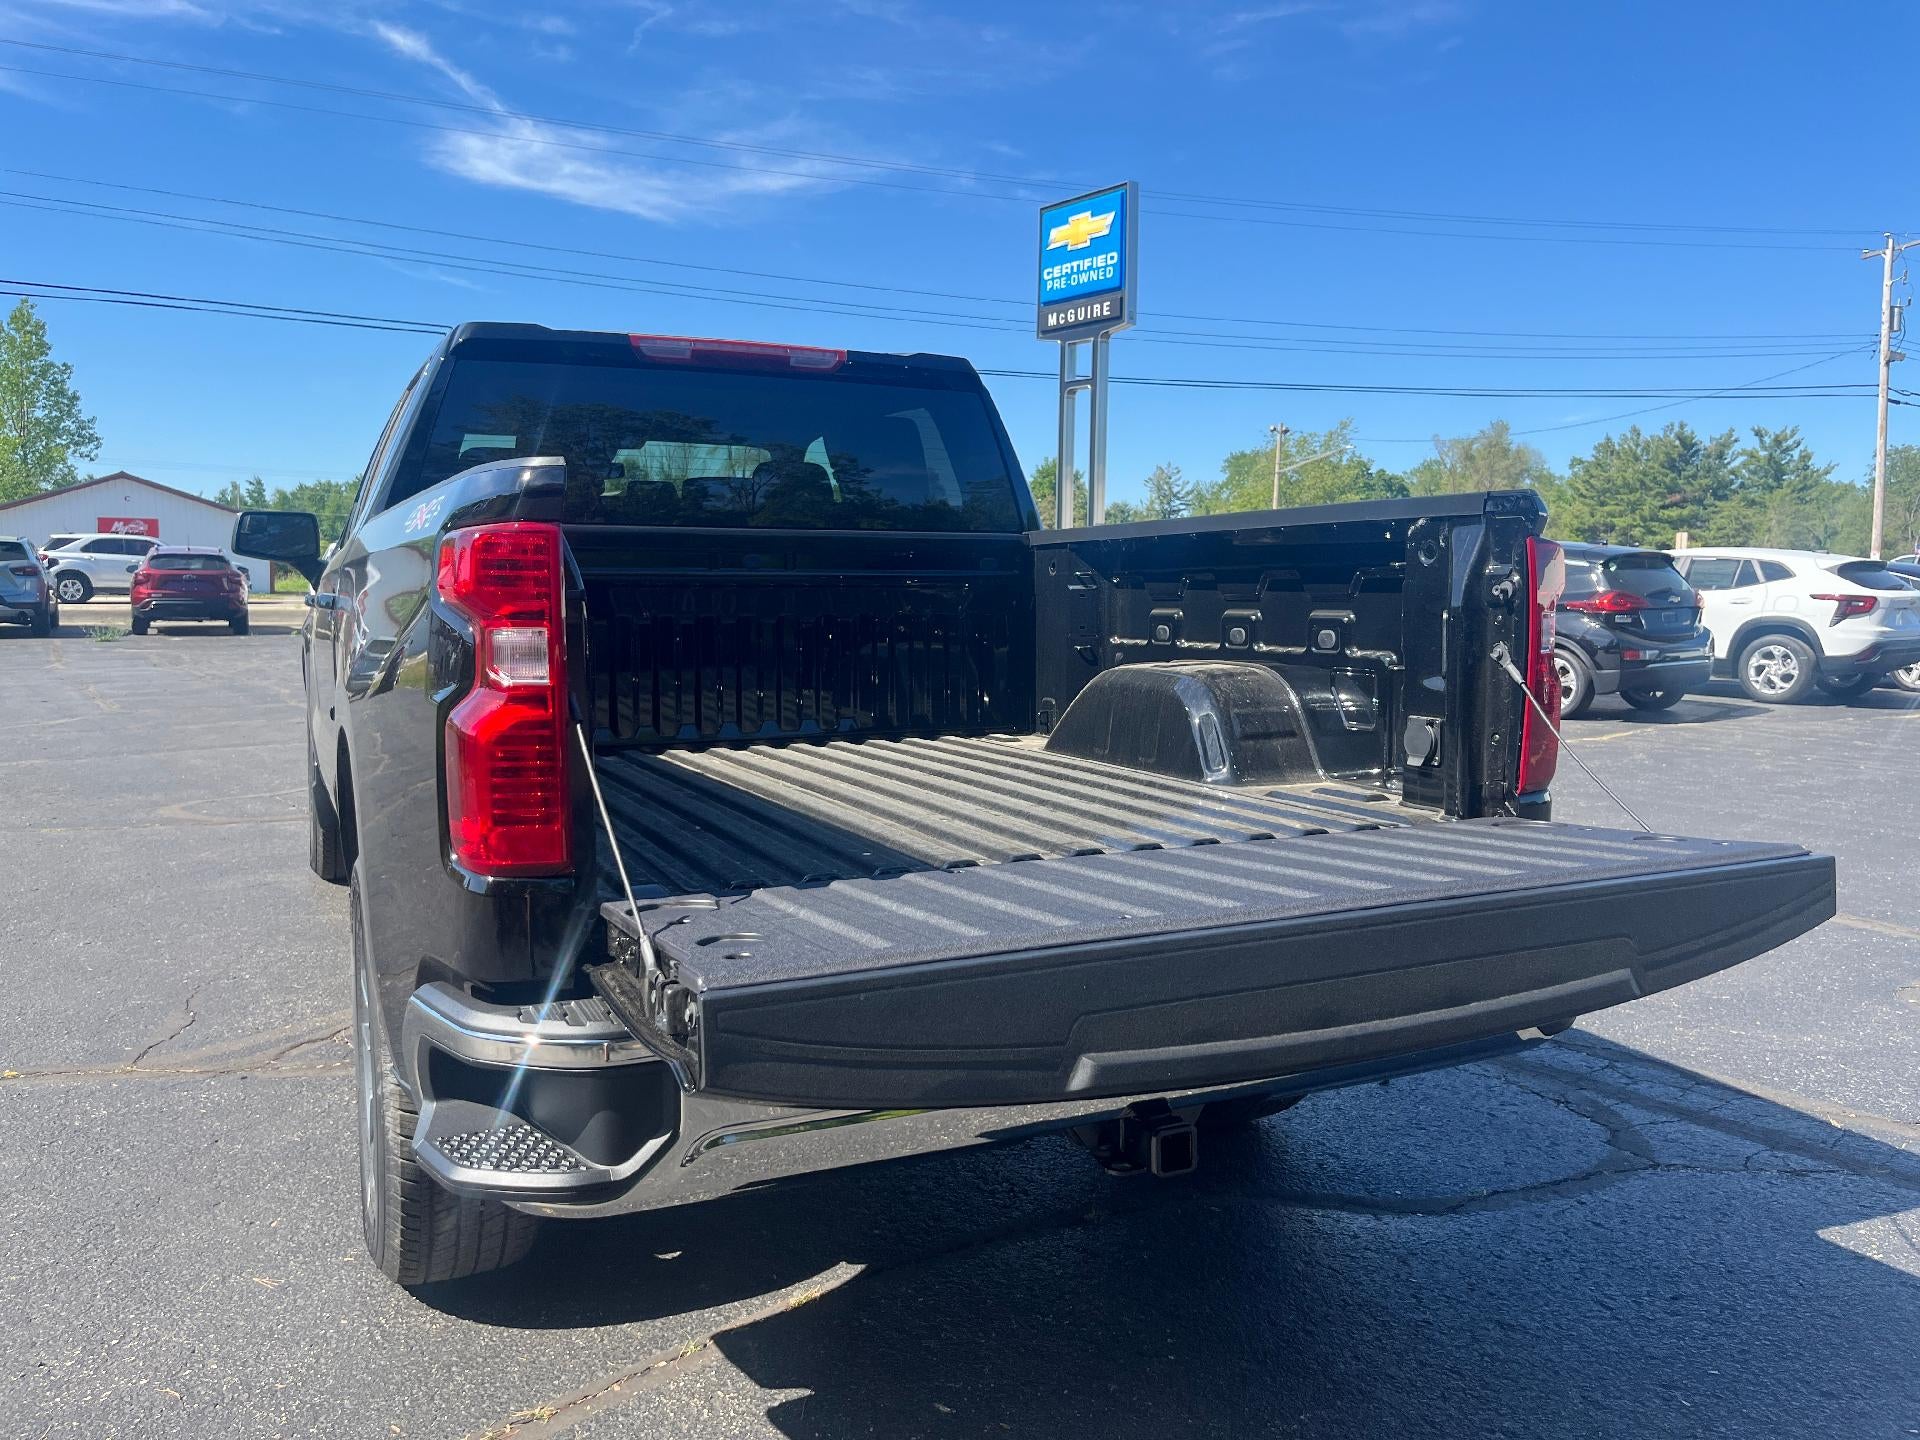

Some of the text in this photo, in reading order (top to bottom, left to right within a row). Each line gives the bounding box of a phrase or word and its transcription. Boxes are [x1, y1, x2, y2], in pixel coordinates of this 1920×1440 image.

[1043, 251, 1118, 281] CERTIFIED
[1046, 266, 1114, 292] PRE-OWNED
[1047, 301, 1111, 327] McGUIRE
